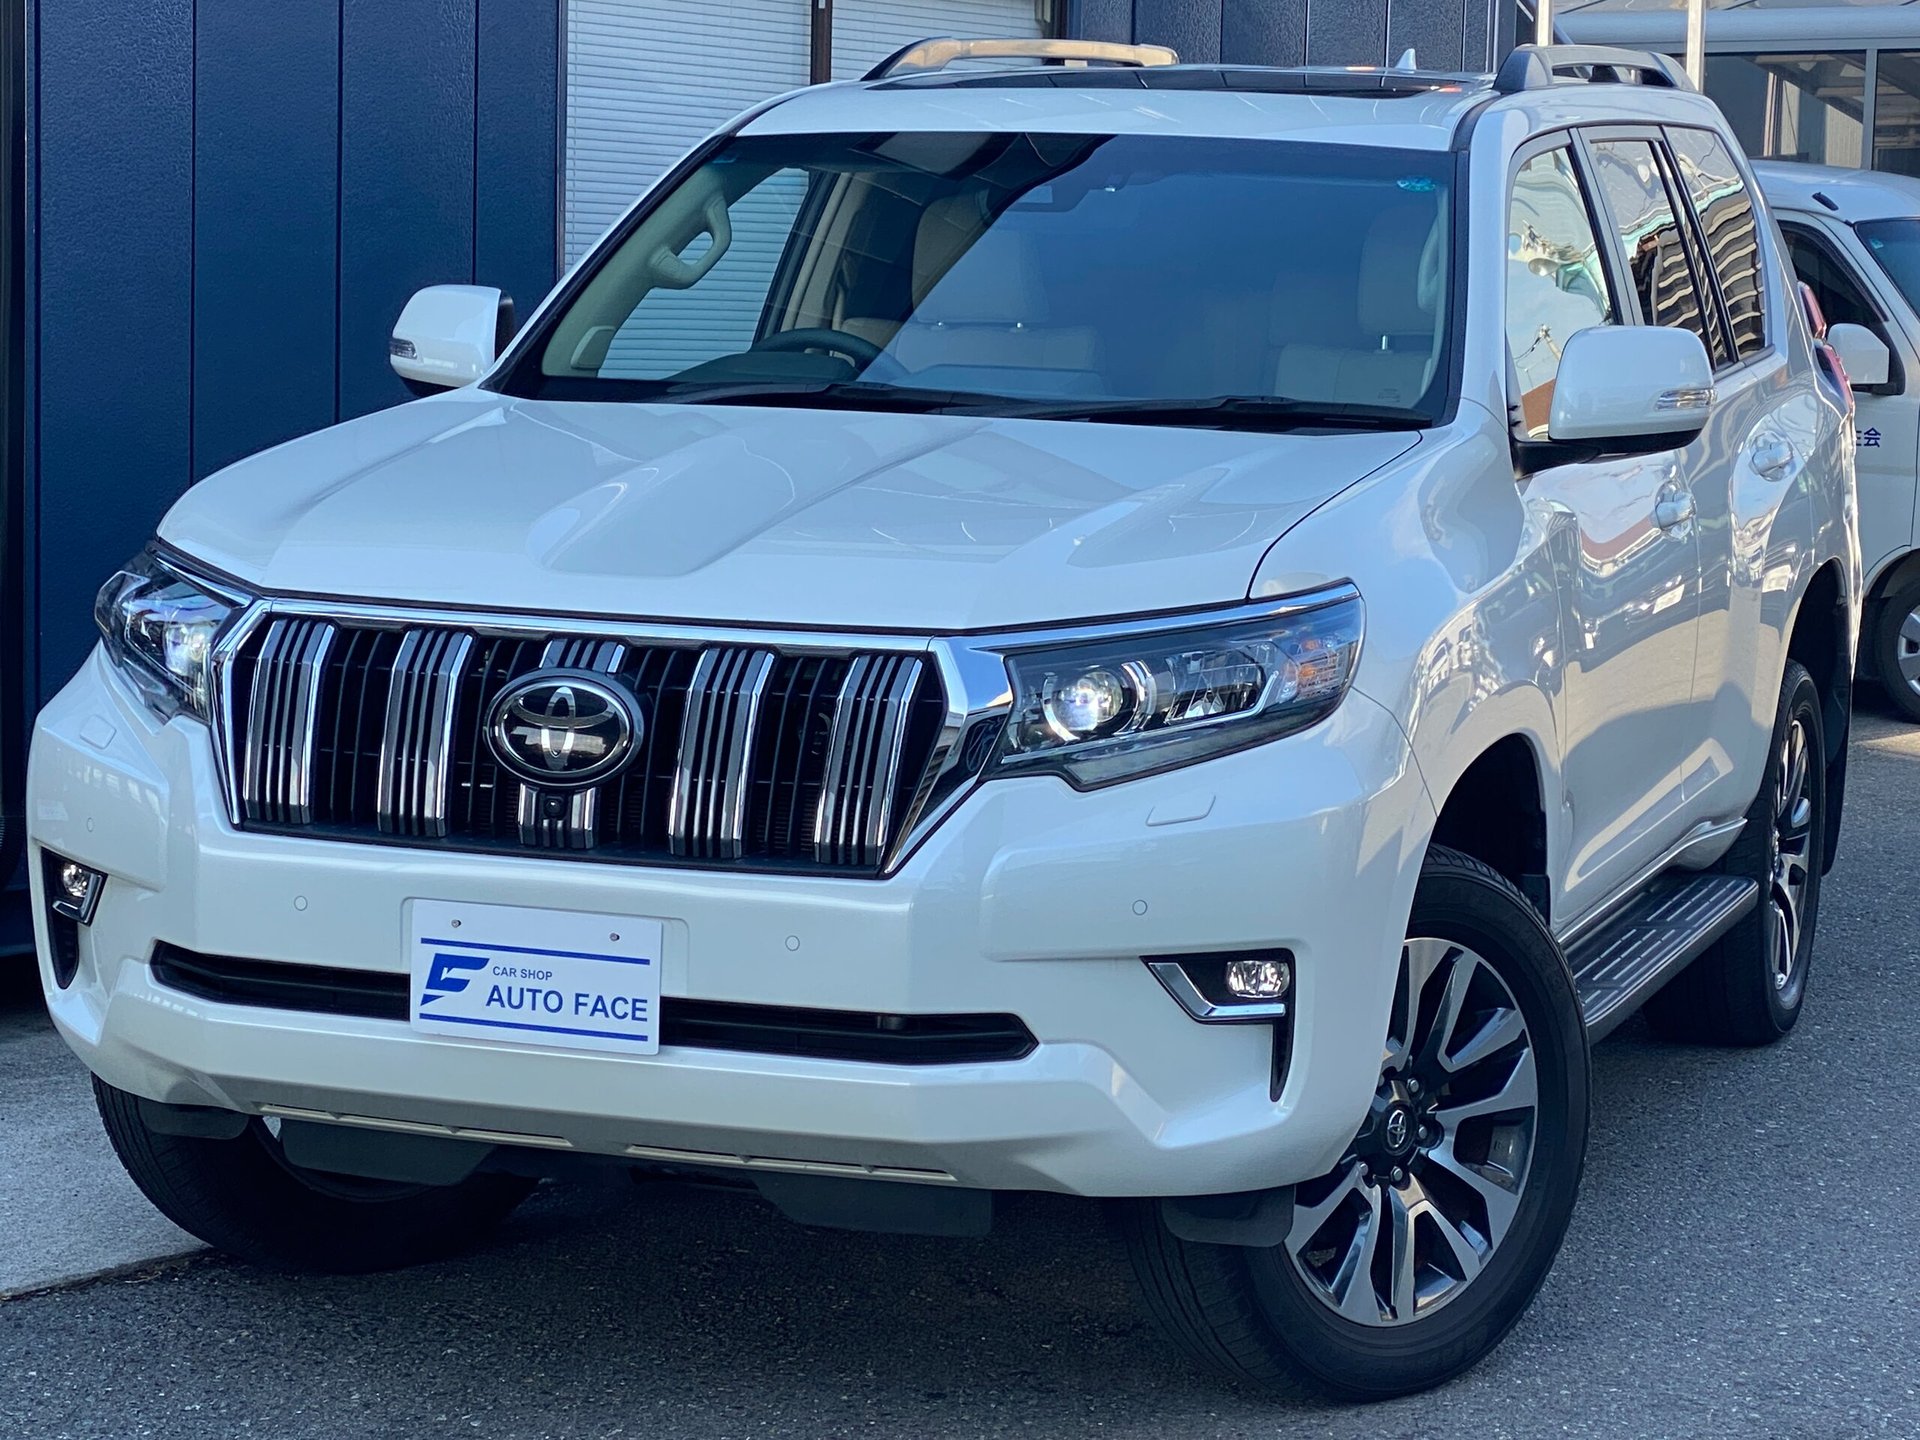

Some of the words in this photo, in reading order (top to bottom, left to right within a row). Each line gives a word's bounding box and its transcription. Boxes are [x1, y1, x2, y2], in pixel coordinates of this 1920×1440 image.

[492, 966, 517, 978] CAR
[520, 968, 553, 981] SHOP
[486, 984, 563, 1013] AUTO
[574, 992, 648, 1022] FACE
